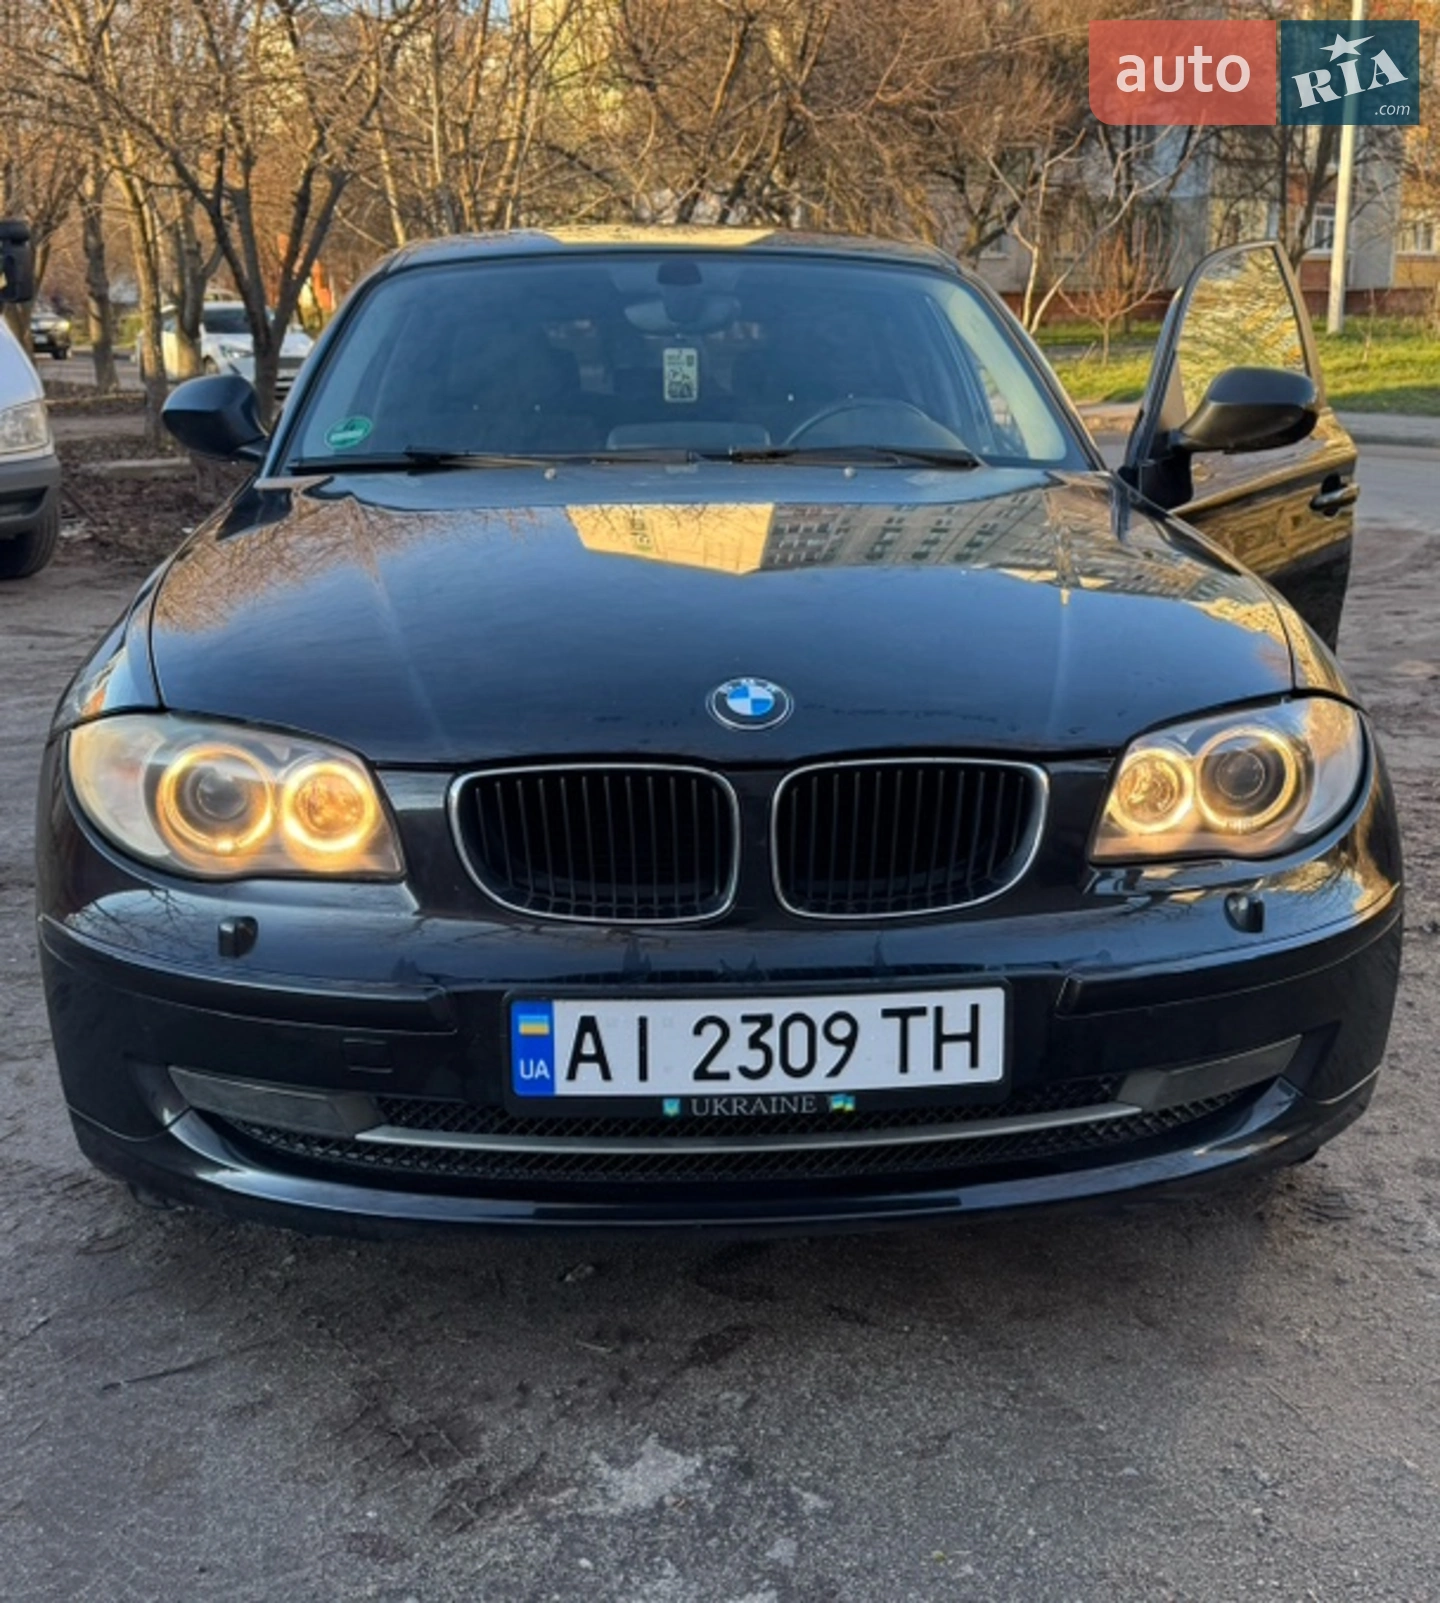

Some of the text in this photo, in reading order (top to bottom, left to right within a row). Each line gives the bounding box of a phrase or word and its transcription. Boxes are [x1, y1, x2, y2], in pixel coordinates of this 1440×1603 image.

[692, 1010, 860, 1081] 2309
[881, 1003, 980, 1074] TH
[519, 1059, 550, 1080] UA
[691, 1095, 817, 1117] UKRAINE
